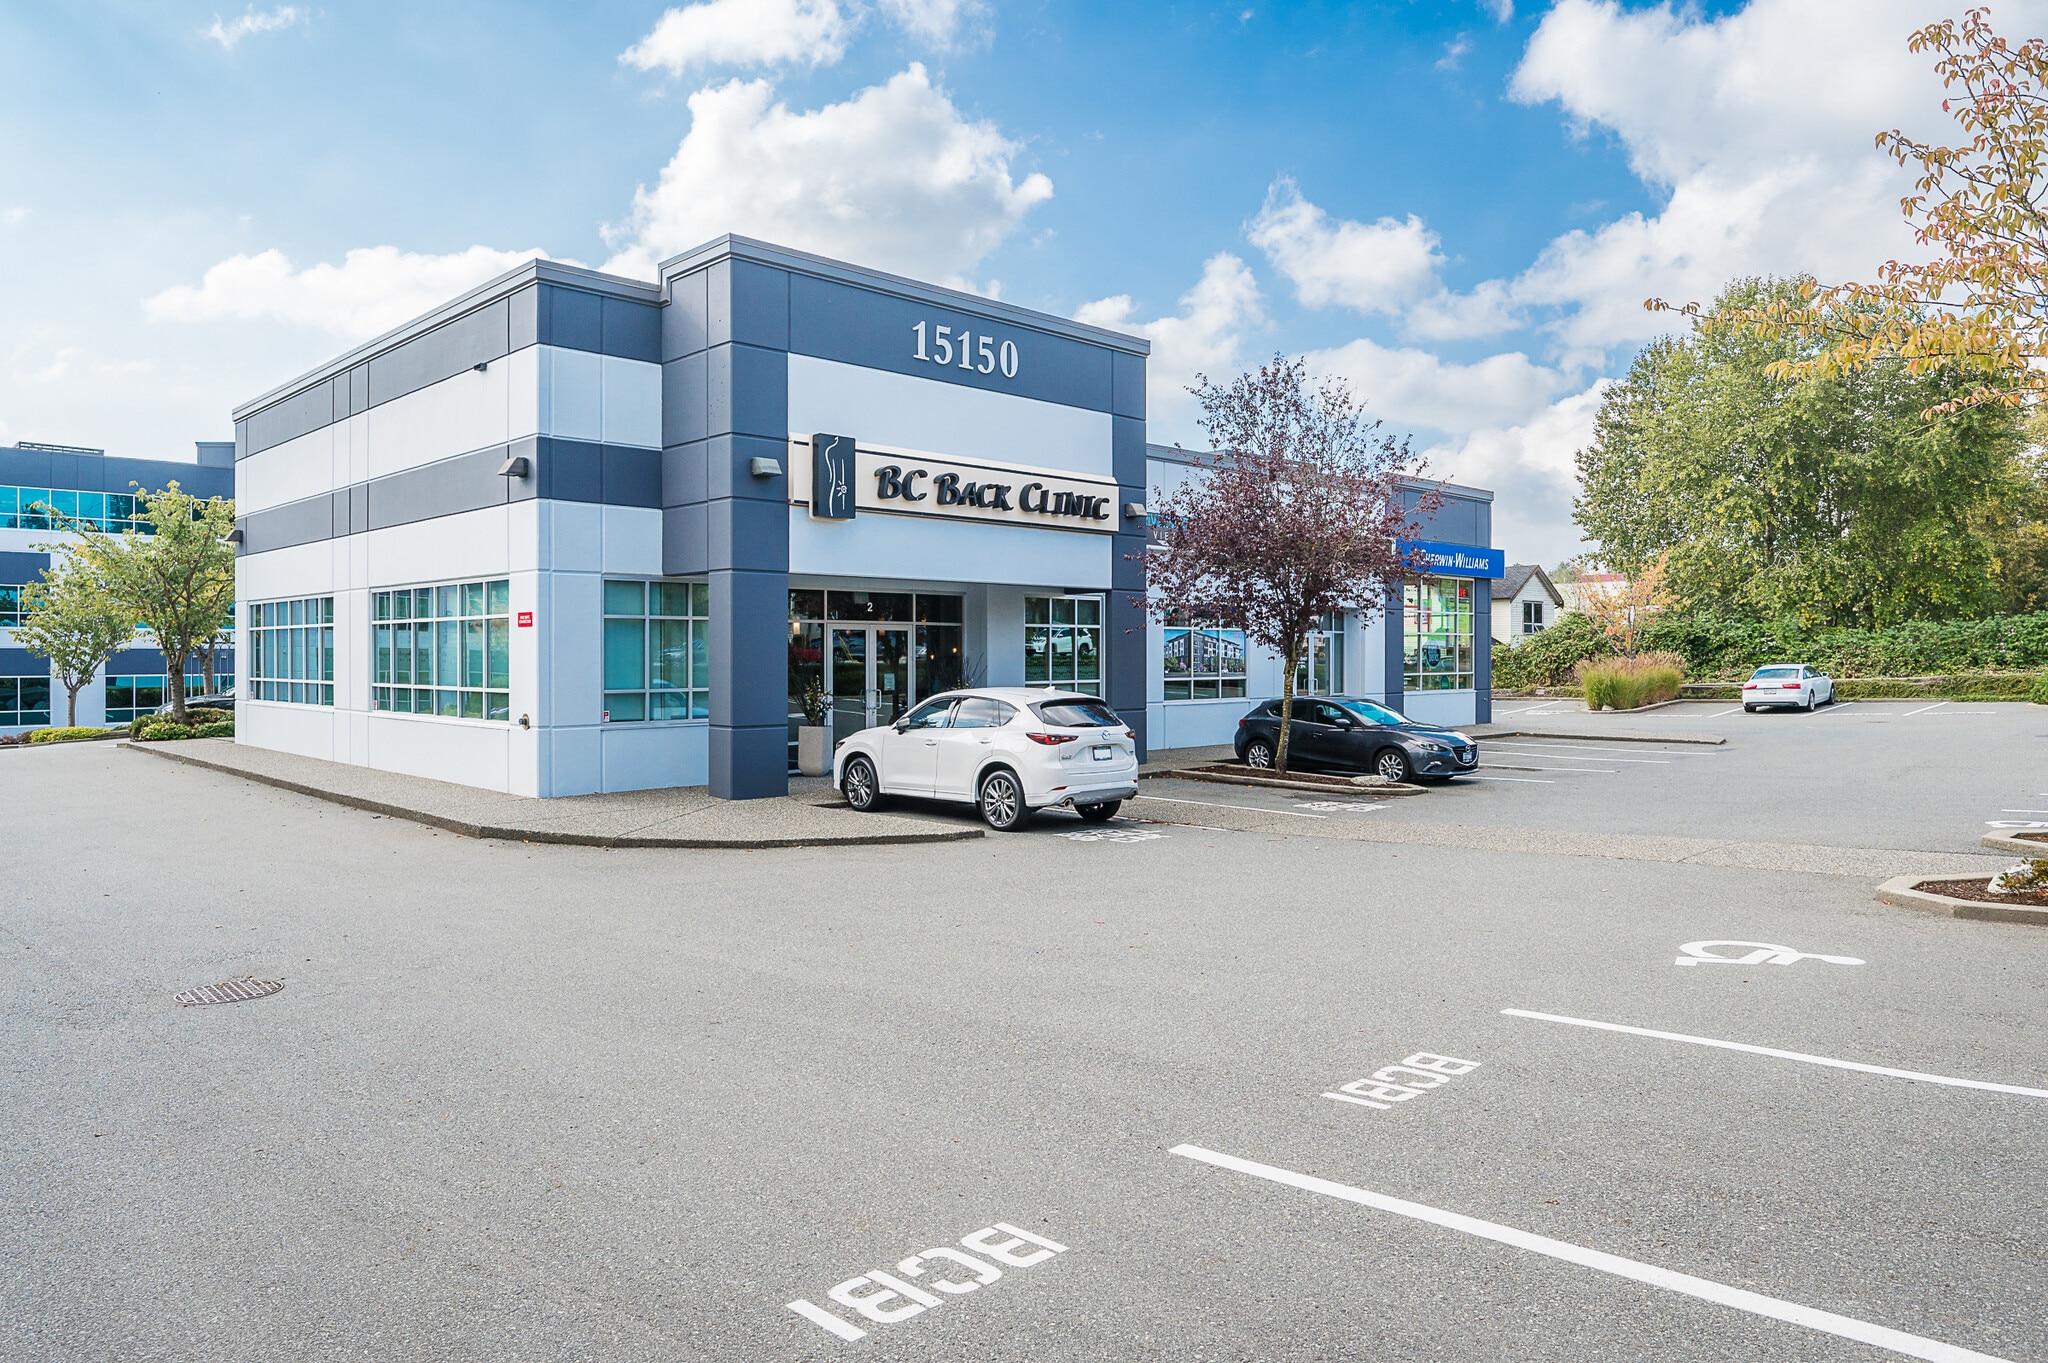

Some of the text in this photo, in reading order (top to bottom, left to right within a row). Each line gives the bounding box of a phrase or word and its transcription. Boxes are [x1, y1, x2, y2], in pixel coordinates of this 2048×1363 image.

[911, 320, 1019, 379] 15150
[873, 464, 1111, 521] BC BACK CLINIC
[867, 602, 873, 612] 2
